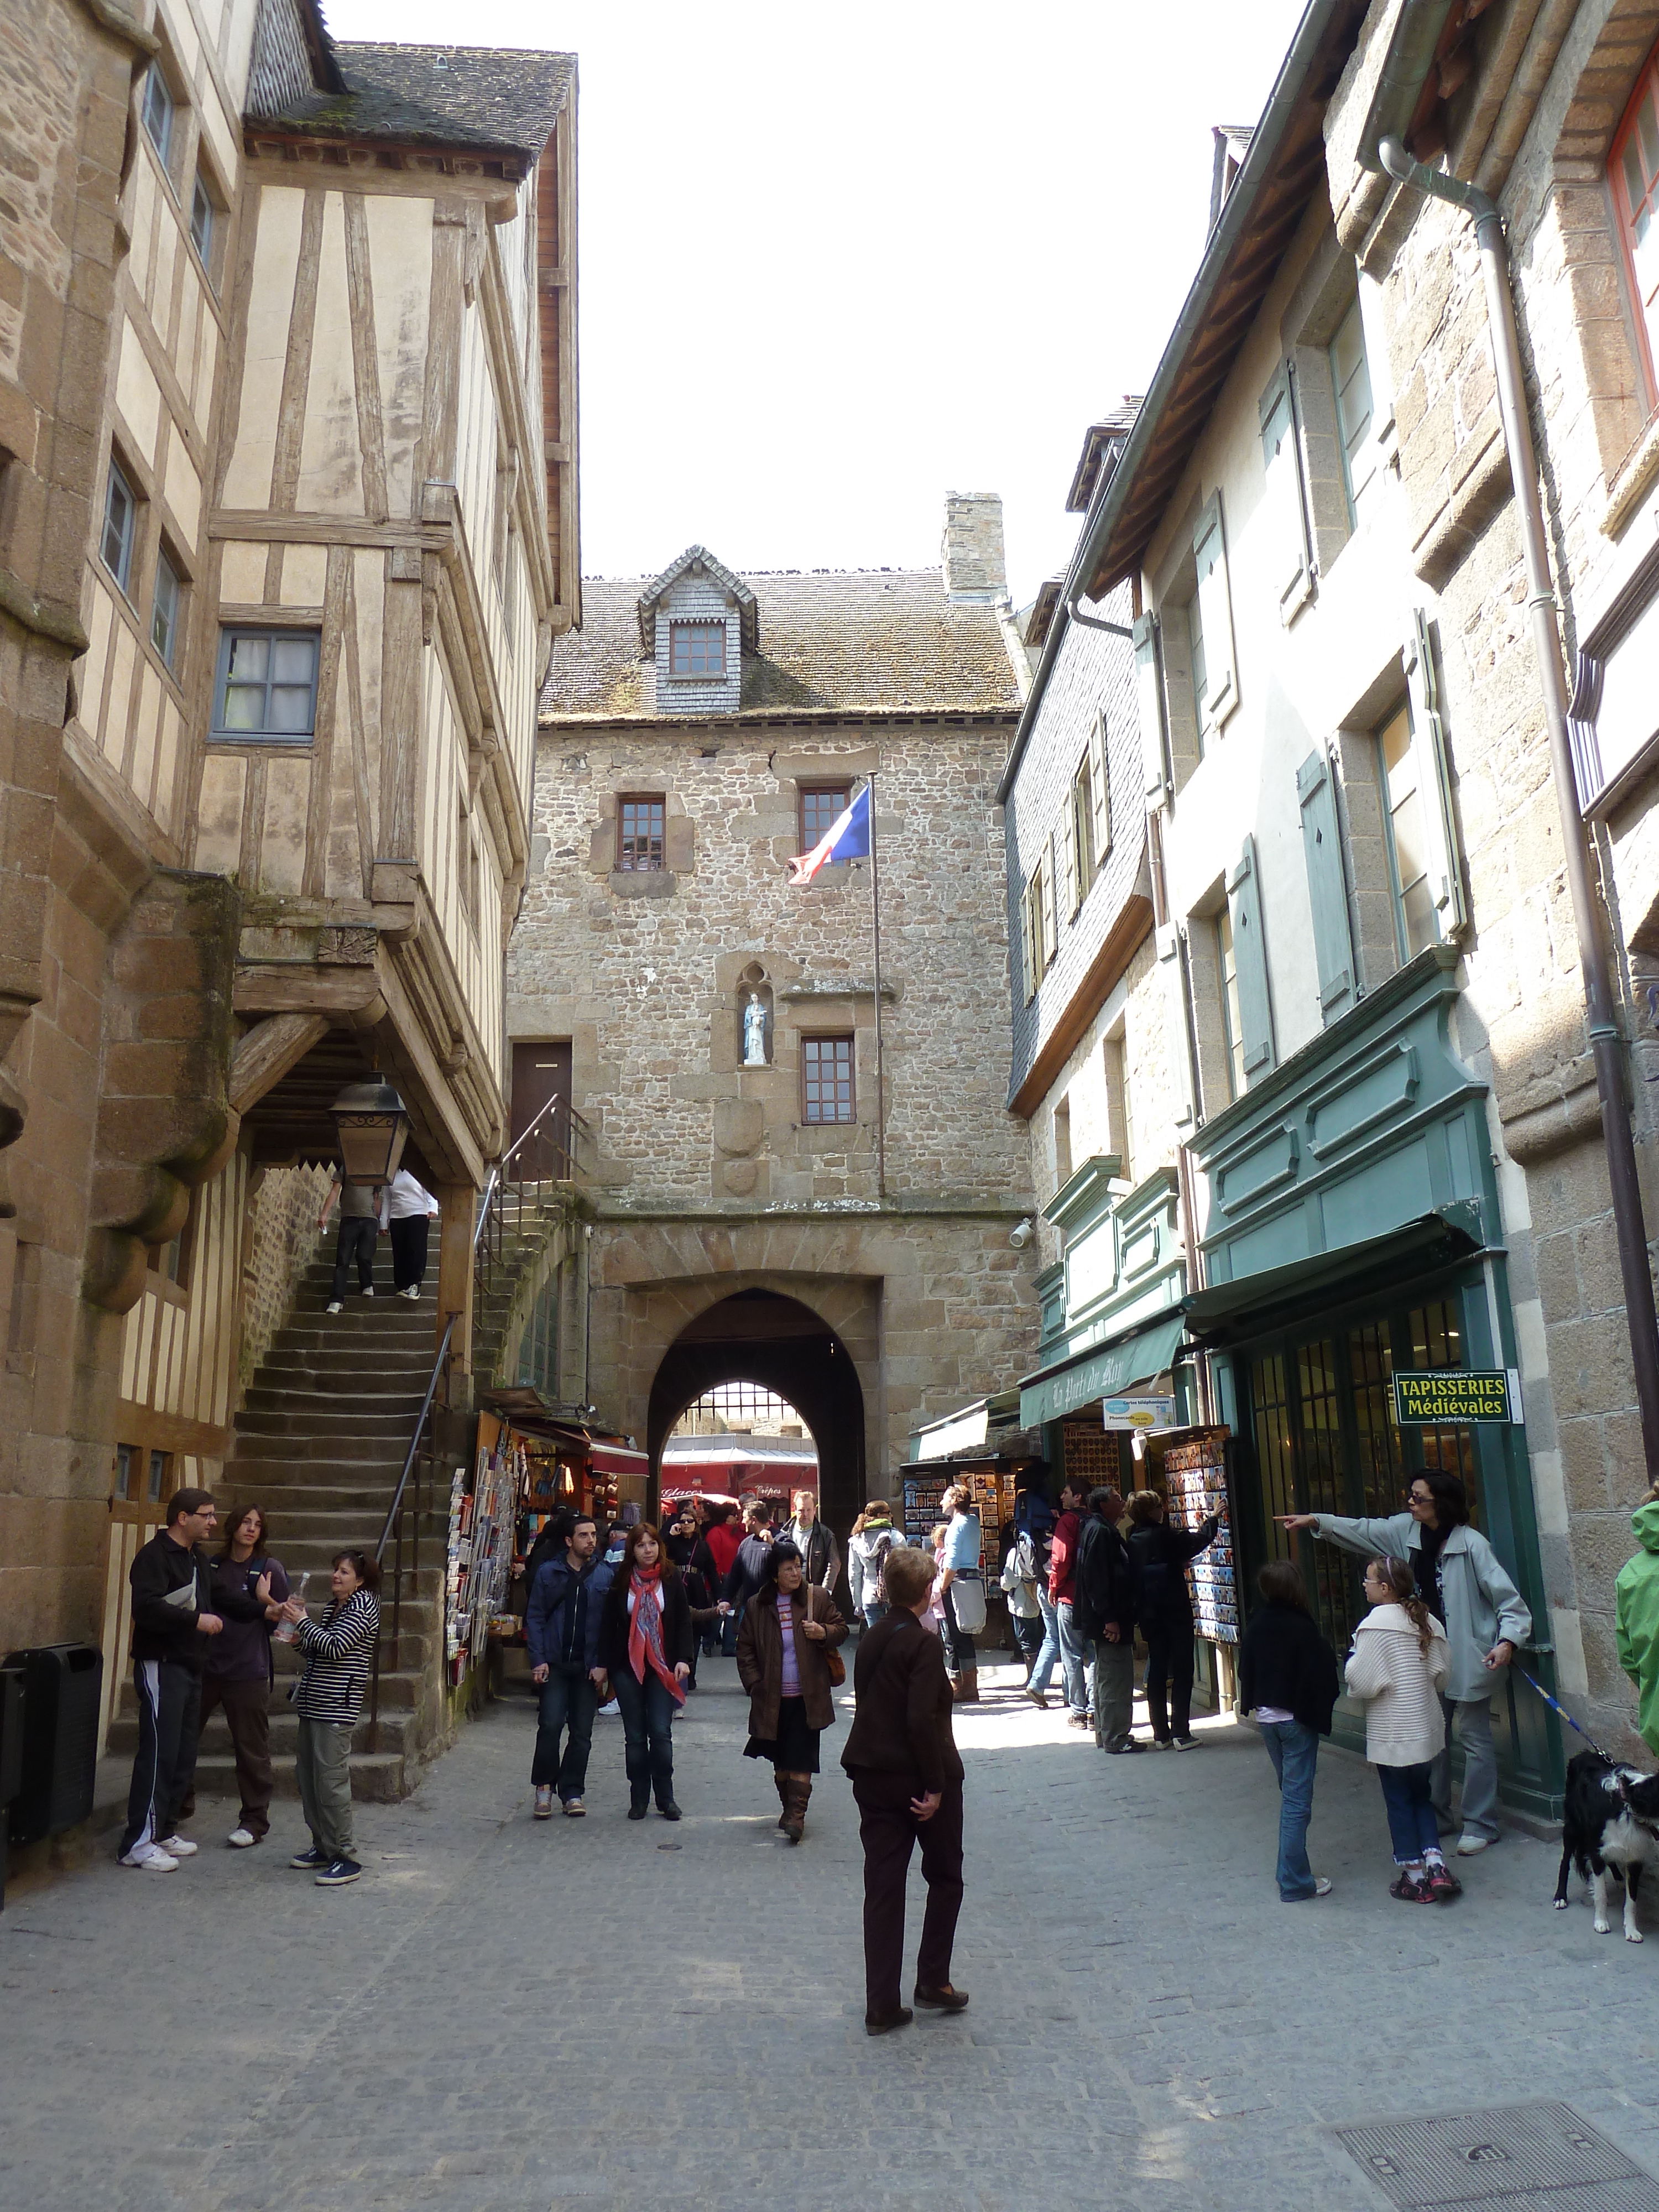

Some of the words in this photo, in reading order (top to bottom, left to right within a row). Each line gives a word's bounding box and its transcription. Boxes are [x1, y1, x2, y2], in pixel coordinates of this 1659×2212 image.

[1399, 1379, 1505, 1396] TAPISSERIES
[1408, 1397, 1502, 1415] Médiévales
[661, 1488, 703, 1498] Glaces
[755, 1485, 781, 1496] Crêpes
